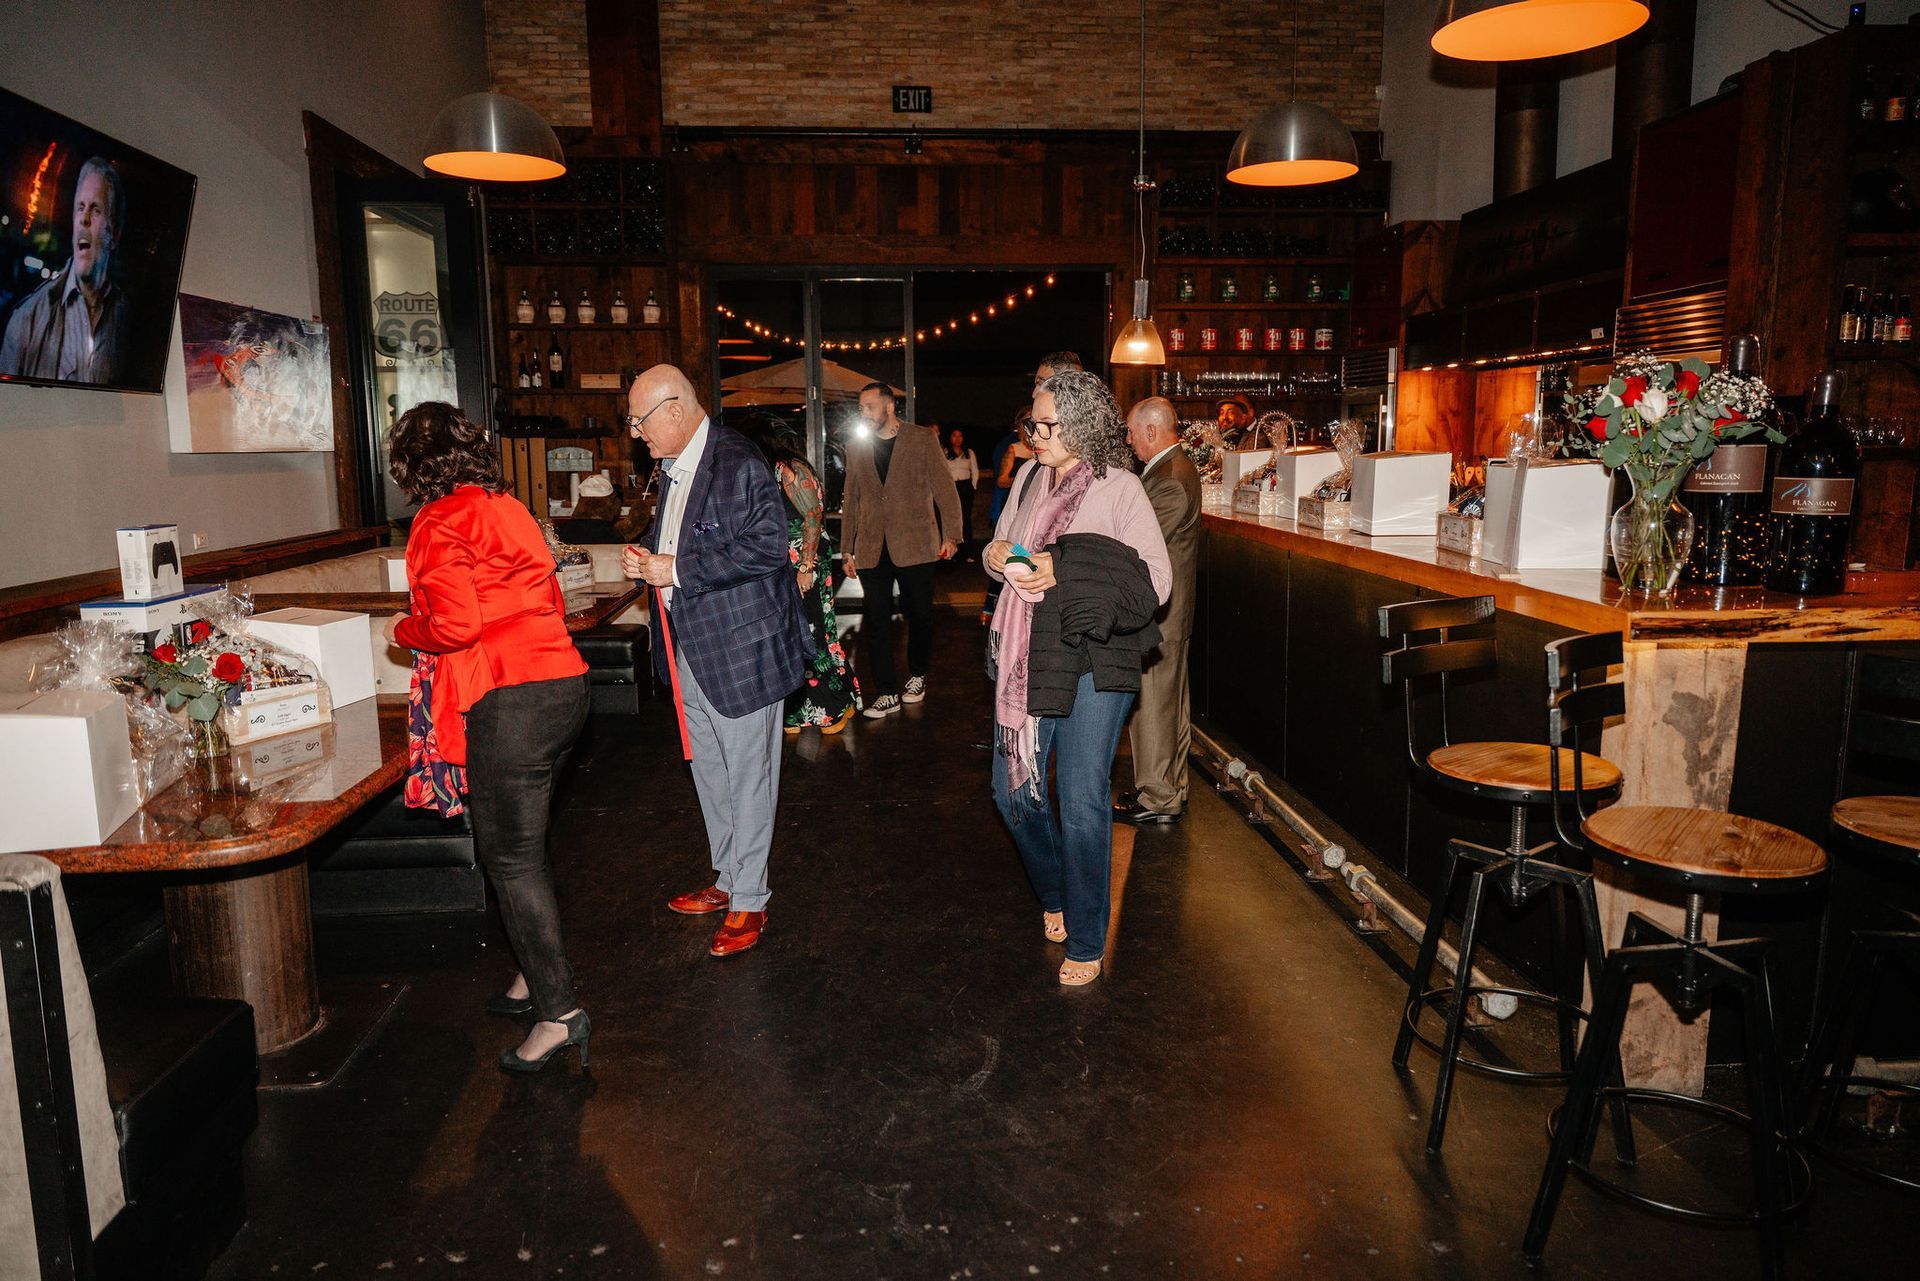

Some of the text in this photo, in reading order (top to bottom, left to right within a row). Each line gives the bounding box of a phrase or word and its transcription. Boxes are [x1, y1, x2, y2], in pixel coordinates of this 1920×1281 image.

[900, 89, 926, 110] EXIT
[380, 298, 436, 312] ROUTE
[378, 318, 438, 354] 66
[1792, 499, 1837, 507] FLANAGAN
